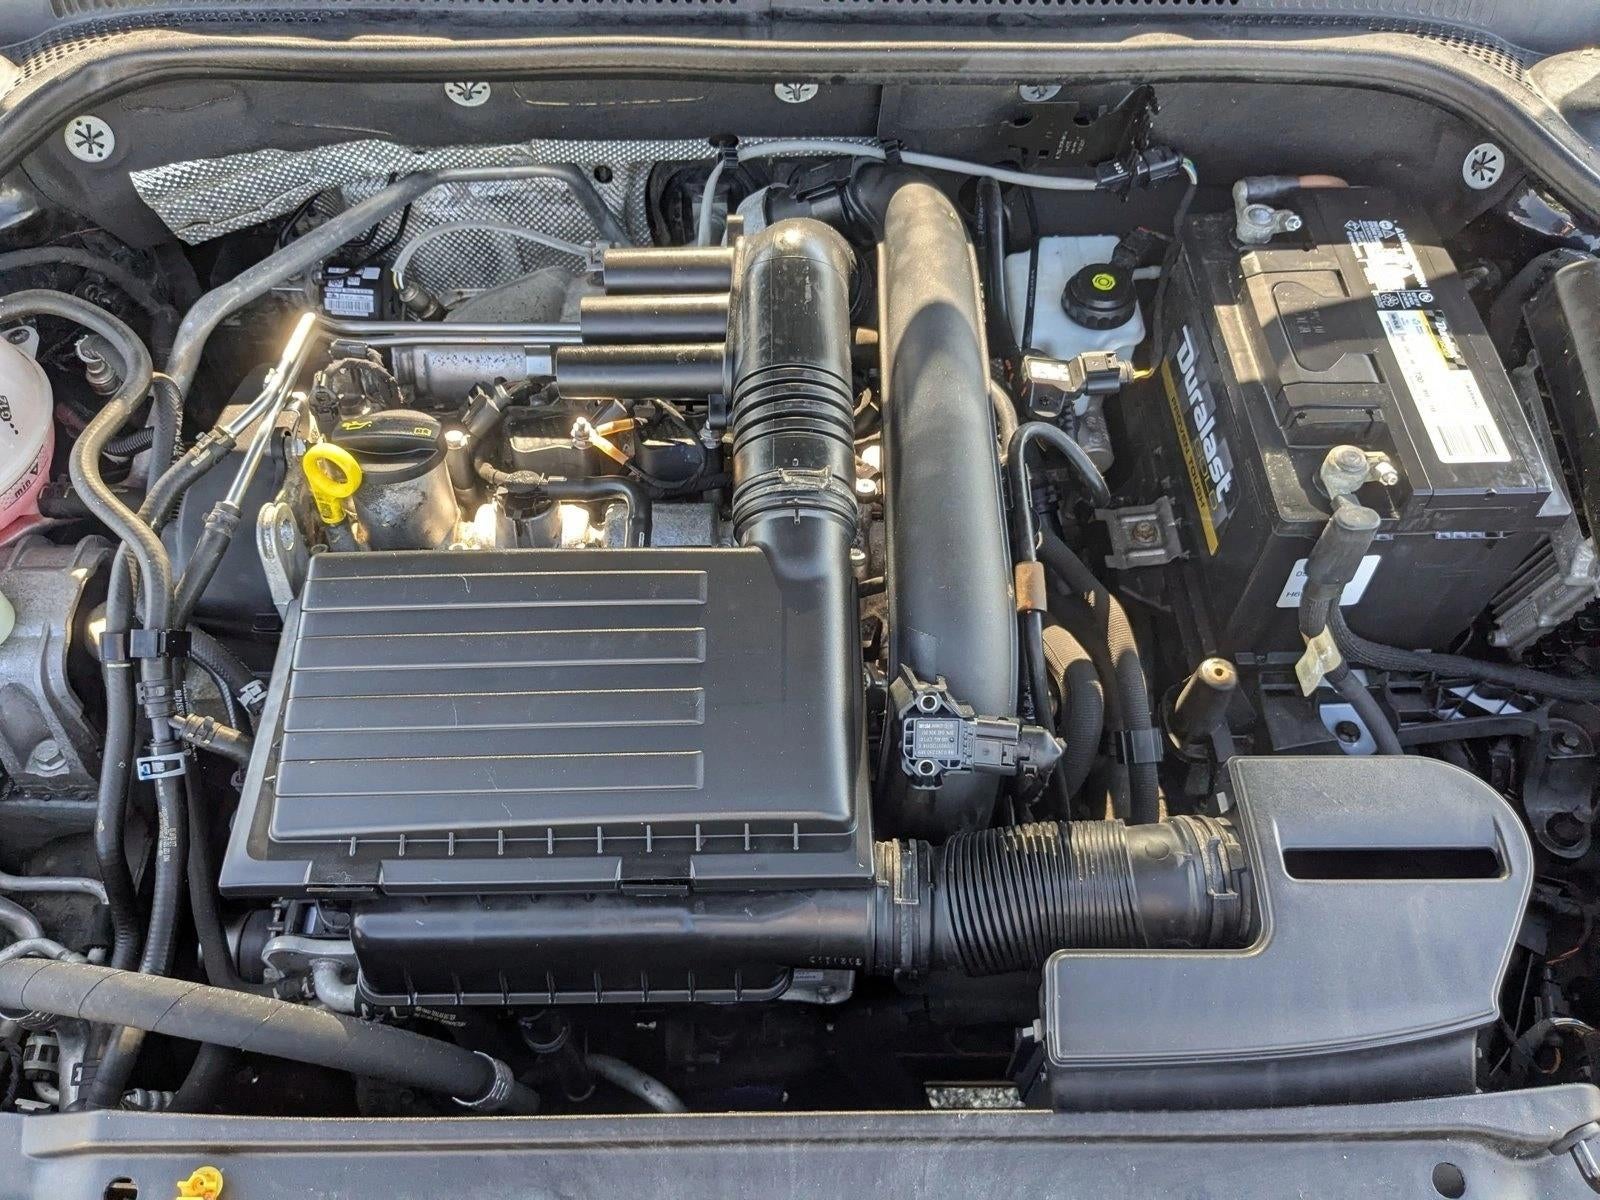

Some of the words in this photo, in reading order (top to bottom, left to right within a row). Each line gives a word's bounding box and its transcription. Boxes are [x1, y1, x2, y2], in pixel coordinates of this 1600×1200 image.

[1171, 396, 1190, 455] PROVEN
[1188, 456, 1205, 508] TOUGH
[1176, 324, 1232, 503] Duralast
[15, 479, 31, 498] min
[1194, 437, 1218, 511] GOLD
